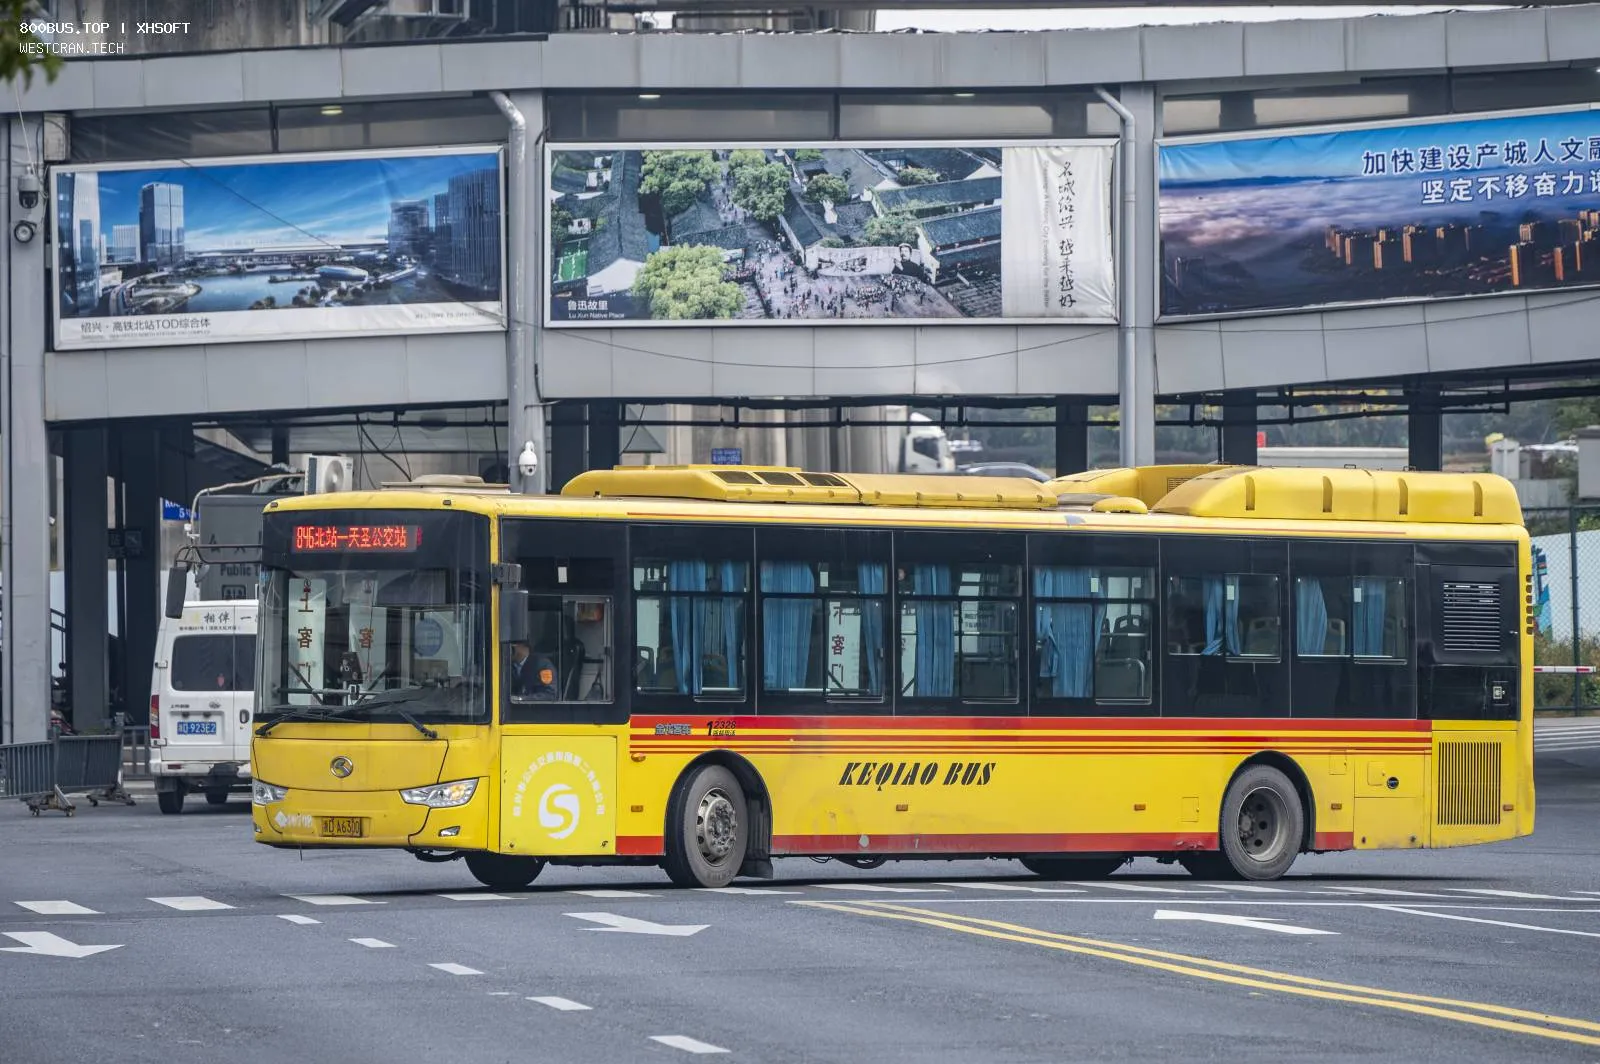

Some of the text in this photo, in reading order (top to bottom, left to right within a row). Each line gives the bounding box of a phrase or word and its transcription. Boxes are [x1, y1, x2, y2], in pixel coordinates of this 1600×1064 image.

[1362, 137, 1600, 175] 加快建设产城人文融
[567, 300, 609, 311] 鲁迅故里
[706, 720, 736, 736] 12328
[838, 762, 997, 792] KEQIAO BUS
